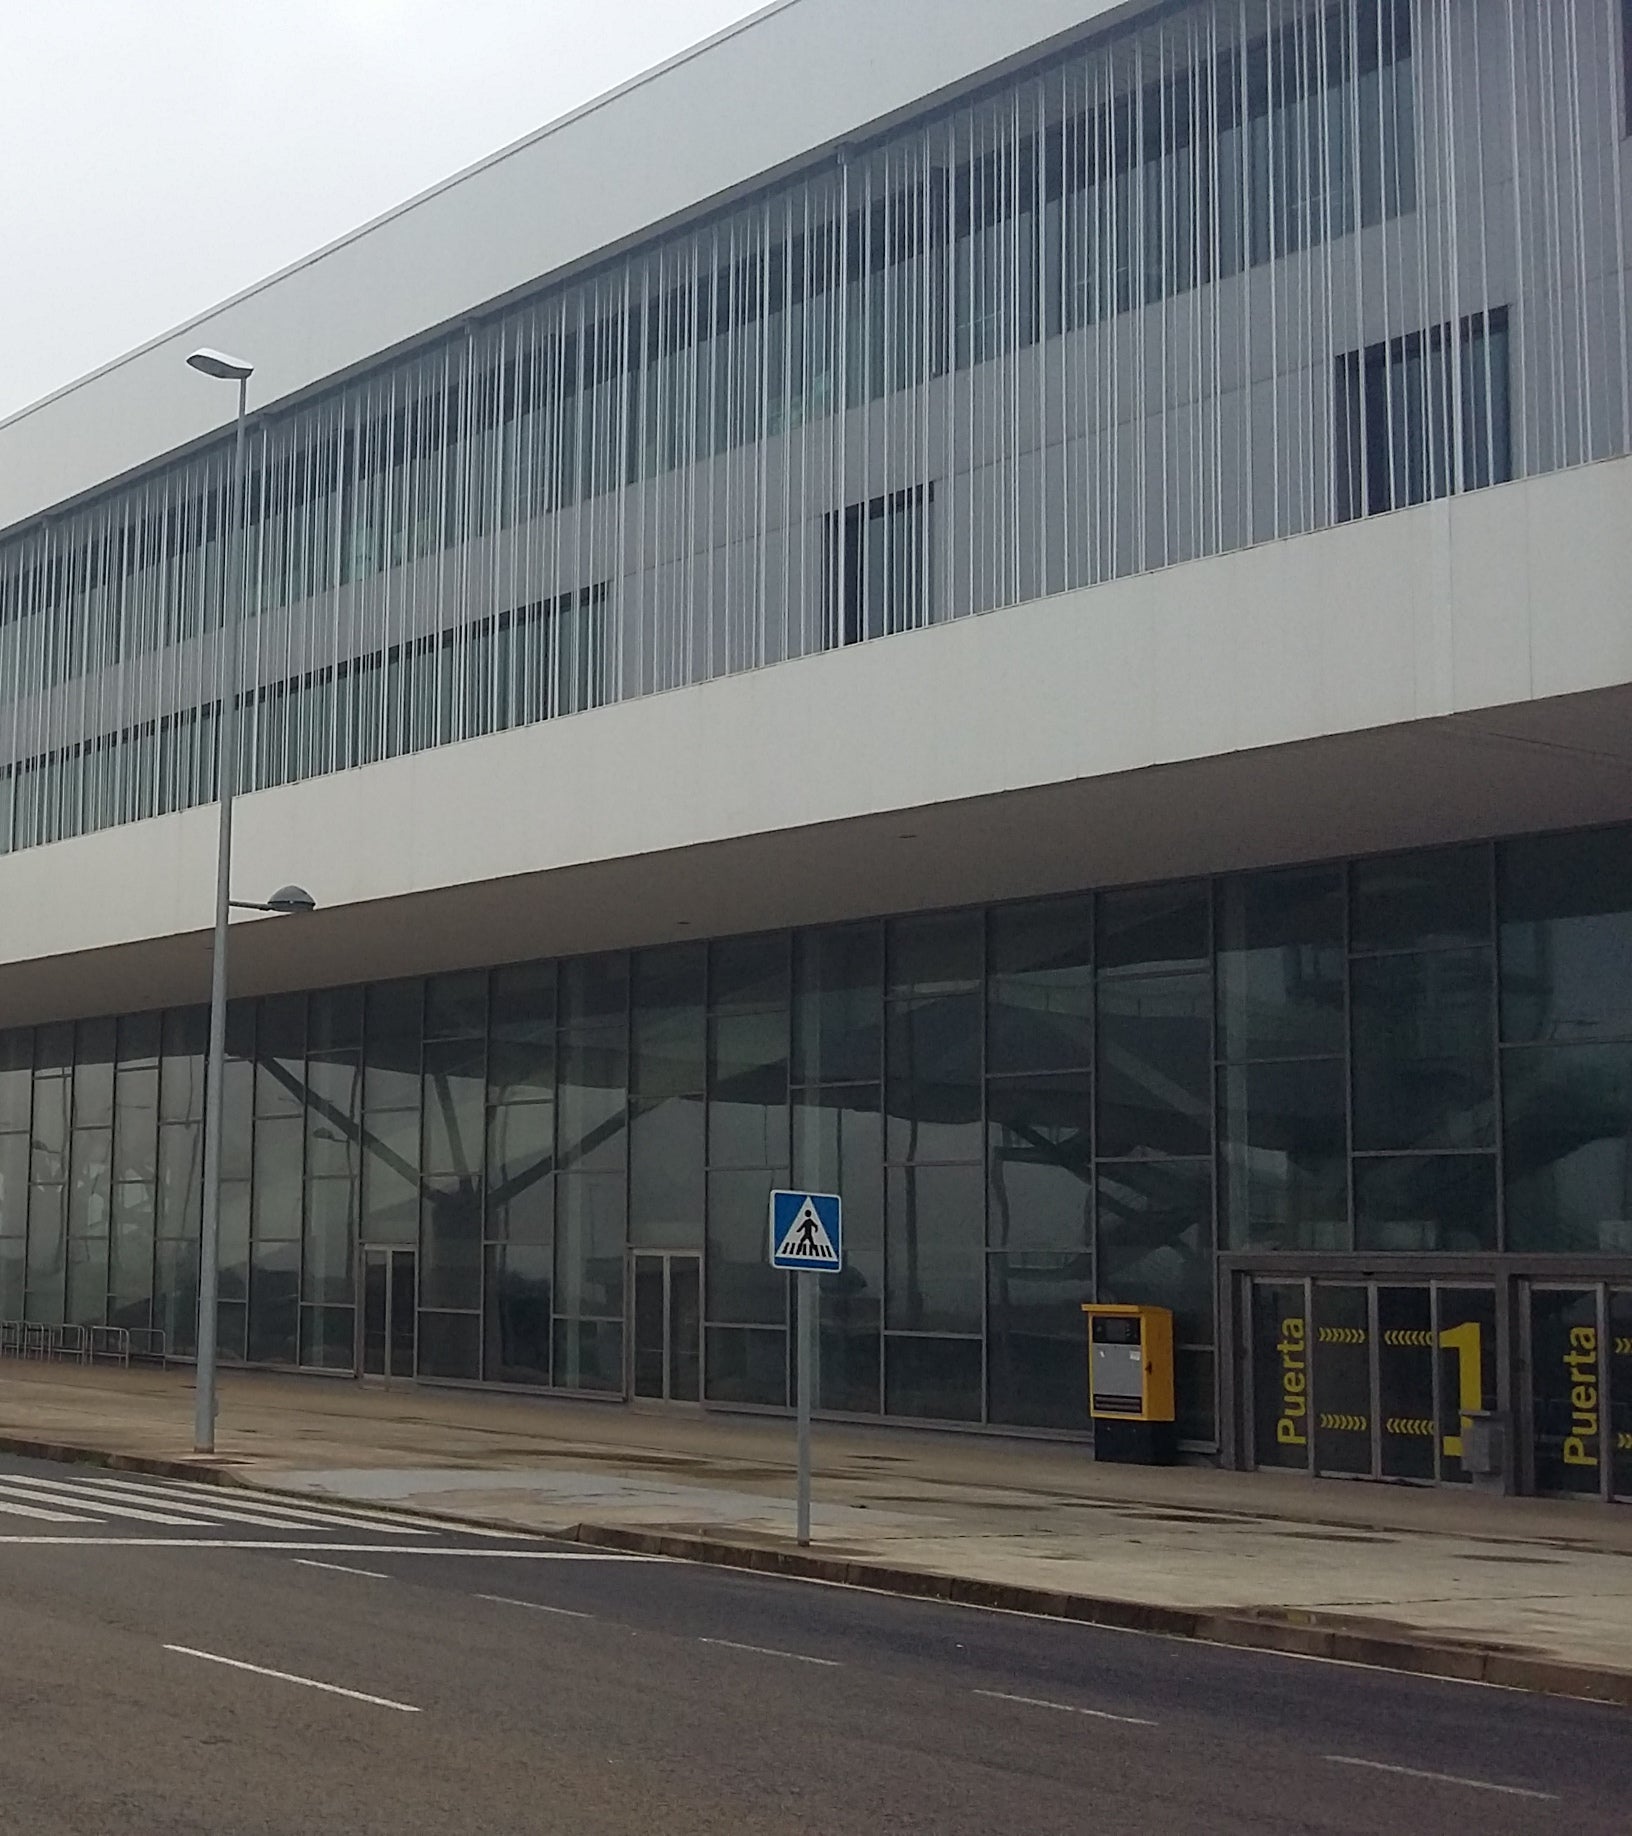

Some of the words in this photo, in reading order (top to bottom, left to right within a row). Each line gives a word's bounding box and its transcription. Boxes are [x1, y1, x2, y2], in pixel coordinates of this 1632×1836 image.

[1277, 1317, 1307, 1445] Puerta
[1439, 1322, 1481, 1456] 1
[1563, 1326, 1598, 1465] Puerta
